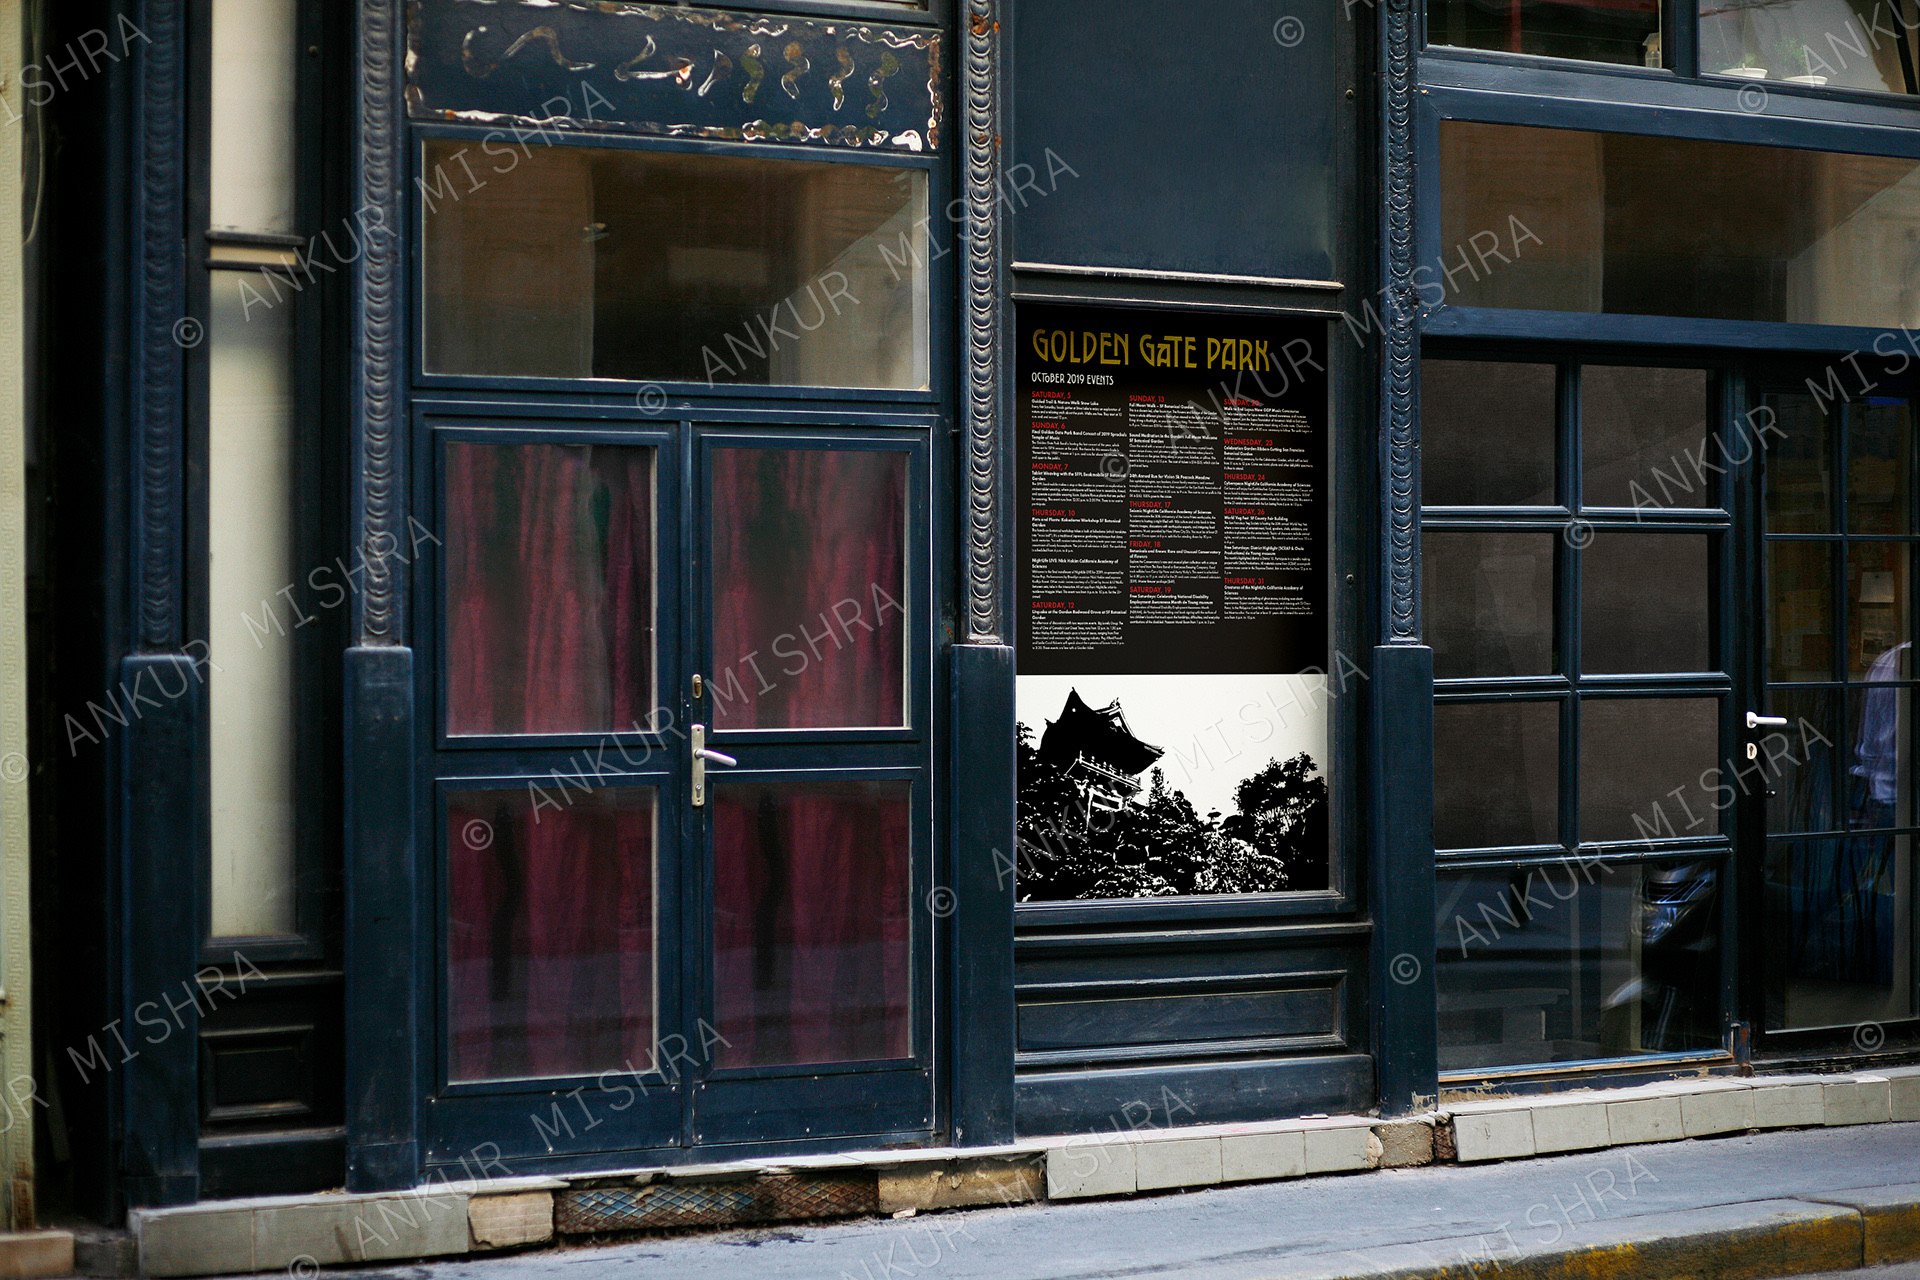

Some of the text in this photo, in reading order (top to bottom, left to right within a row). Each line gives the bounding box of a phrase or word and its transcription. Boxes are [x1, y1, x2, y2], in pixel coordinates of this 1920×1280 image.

[1032, 329, 1270, 371] GOLDEN GATE PARK
[1031, 372, 1114, 386] OCTOBER 2019 EVENTS
